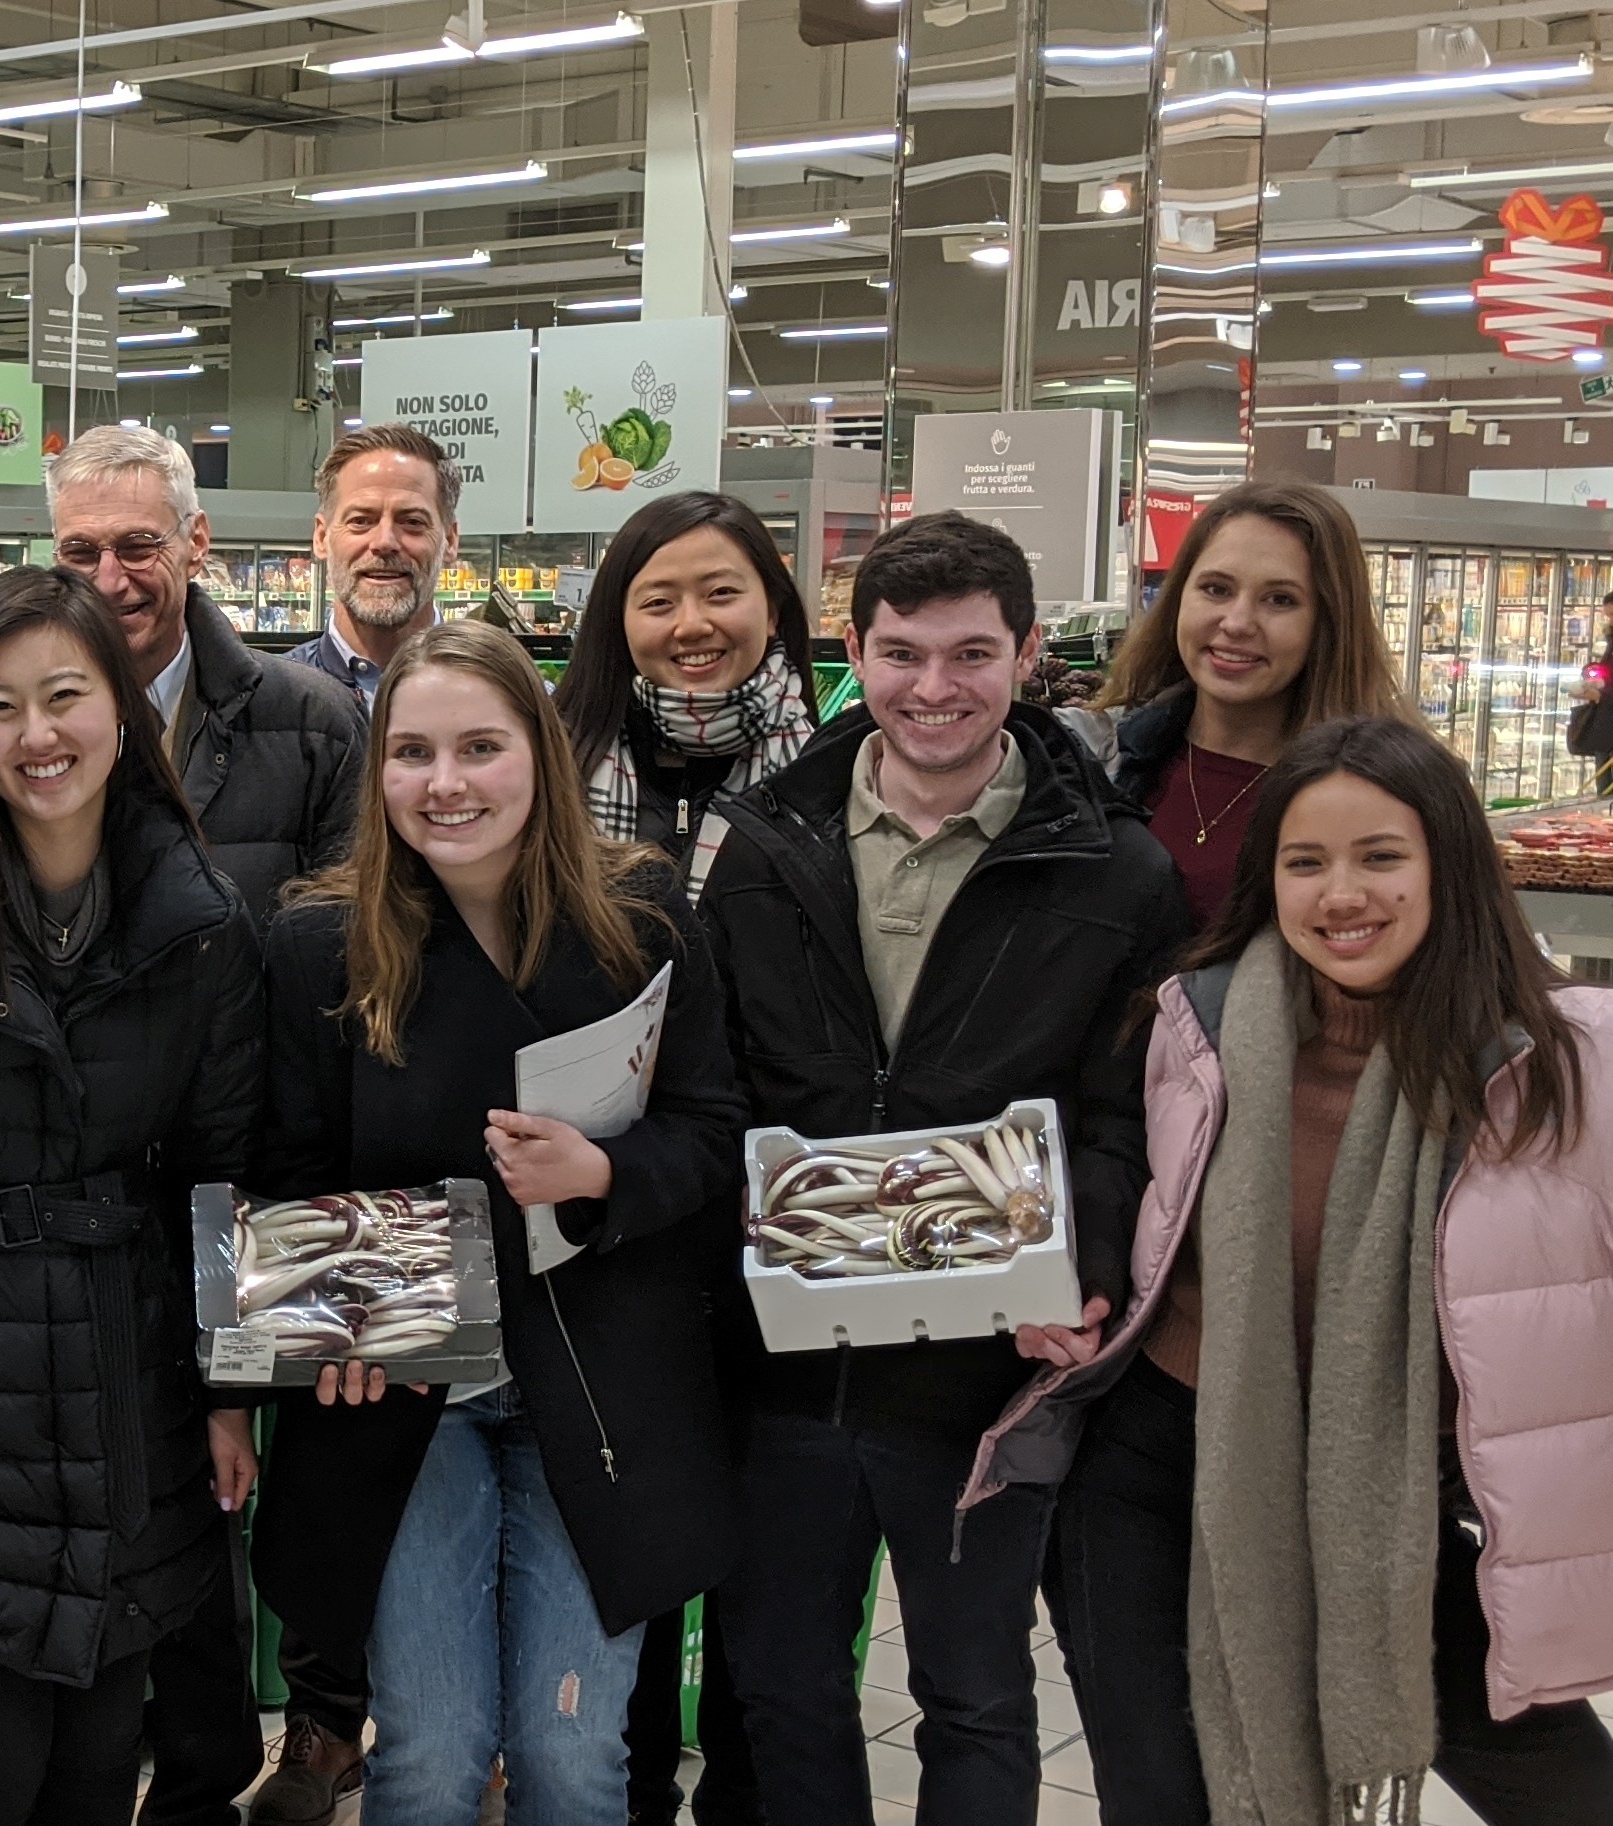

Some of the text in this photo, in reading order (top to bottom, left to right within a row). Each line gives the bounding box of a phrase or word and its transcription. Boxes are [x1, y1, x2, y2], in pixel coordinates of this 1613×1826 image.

[396, 393, 488, 415] NON SOLO
[965, 464, 999, 473] Indossa
[1006, 461, 1035, 475] guanti
[970, 473, 1028, 485] per scegliere
[963, 485, 988, 494] frutta
[998, 484, 1035, 493] verdura.
